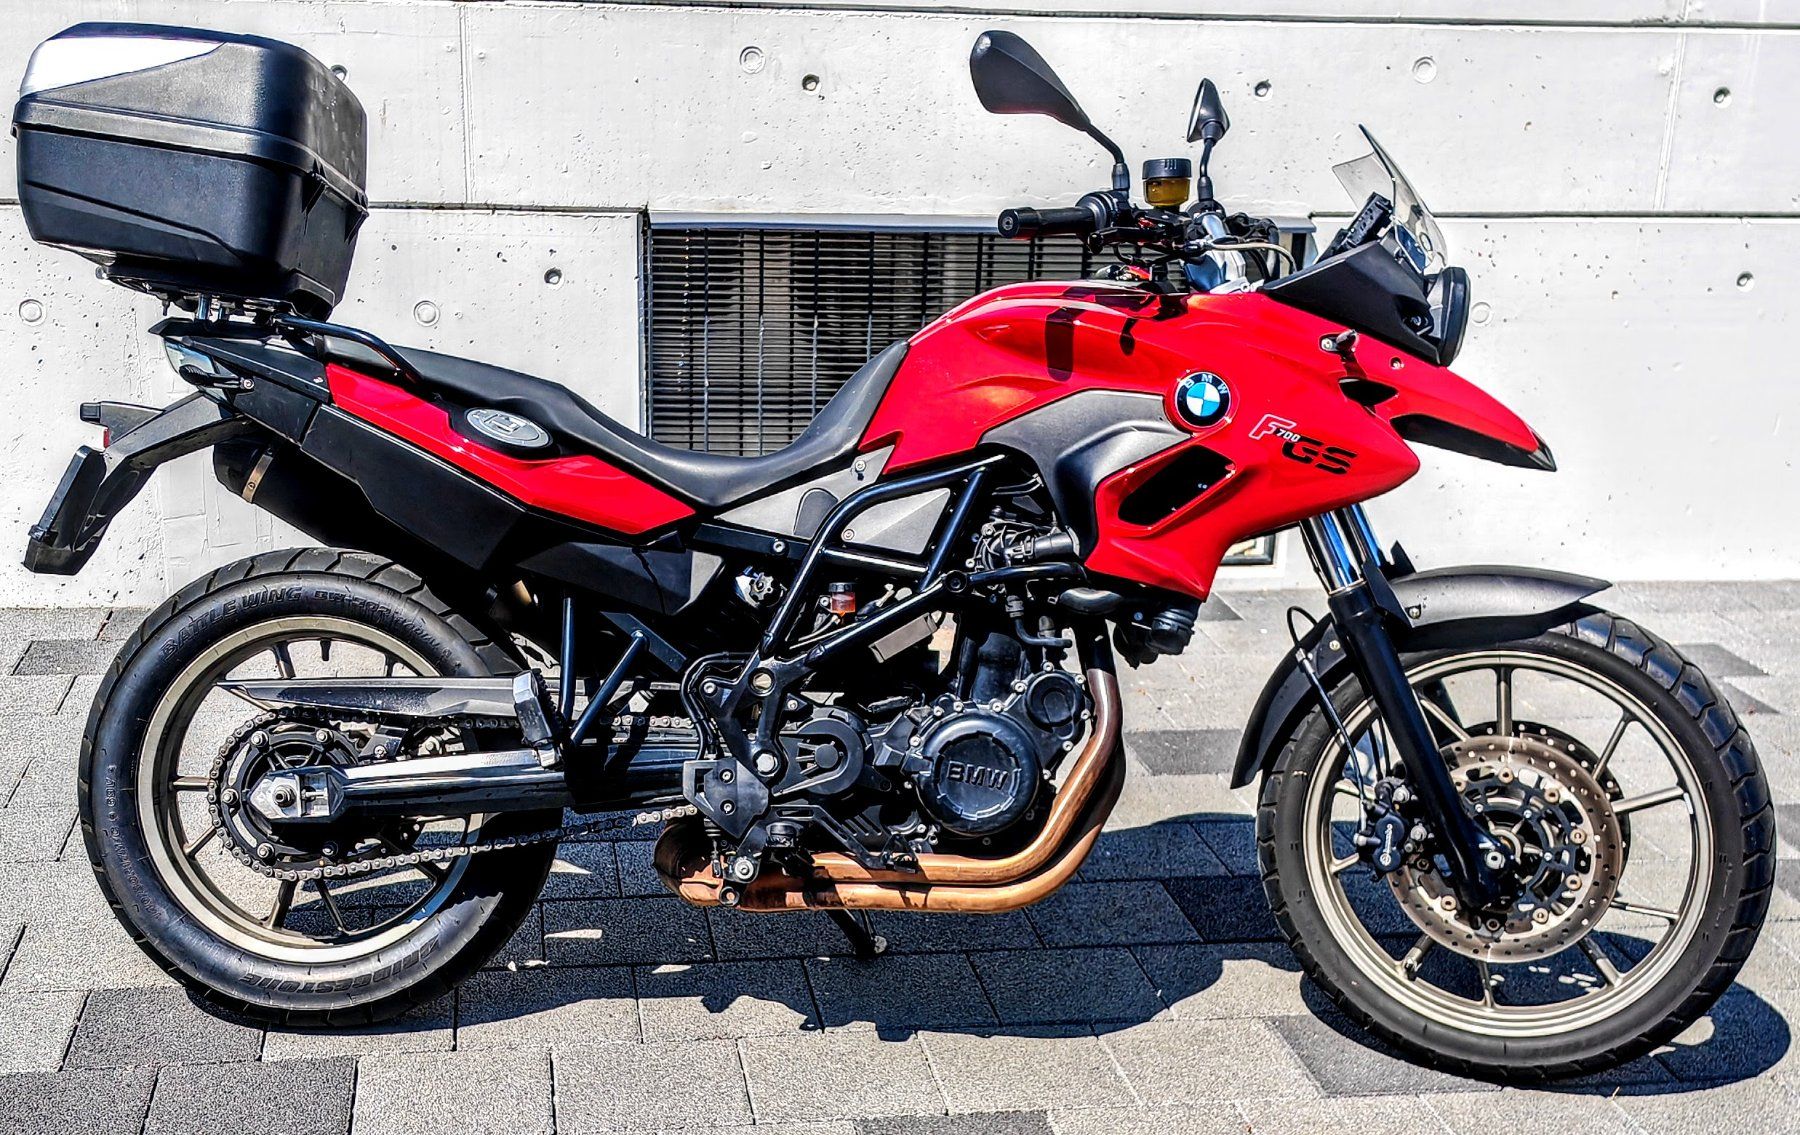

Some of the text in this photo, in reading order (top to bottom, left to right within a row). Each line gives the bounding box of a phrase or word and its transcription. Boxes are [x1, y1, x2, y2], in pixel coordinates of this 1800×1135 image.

[1183, 372, 1229, 395] BMW
[1276, 428, 1301, 442] 700
[1282, 434, 1358, 475] GS
[946, 760, 1009, 791] BMW
[239, 934, 440, 994] BRIDGESTONE
